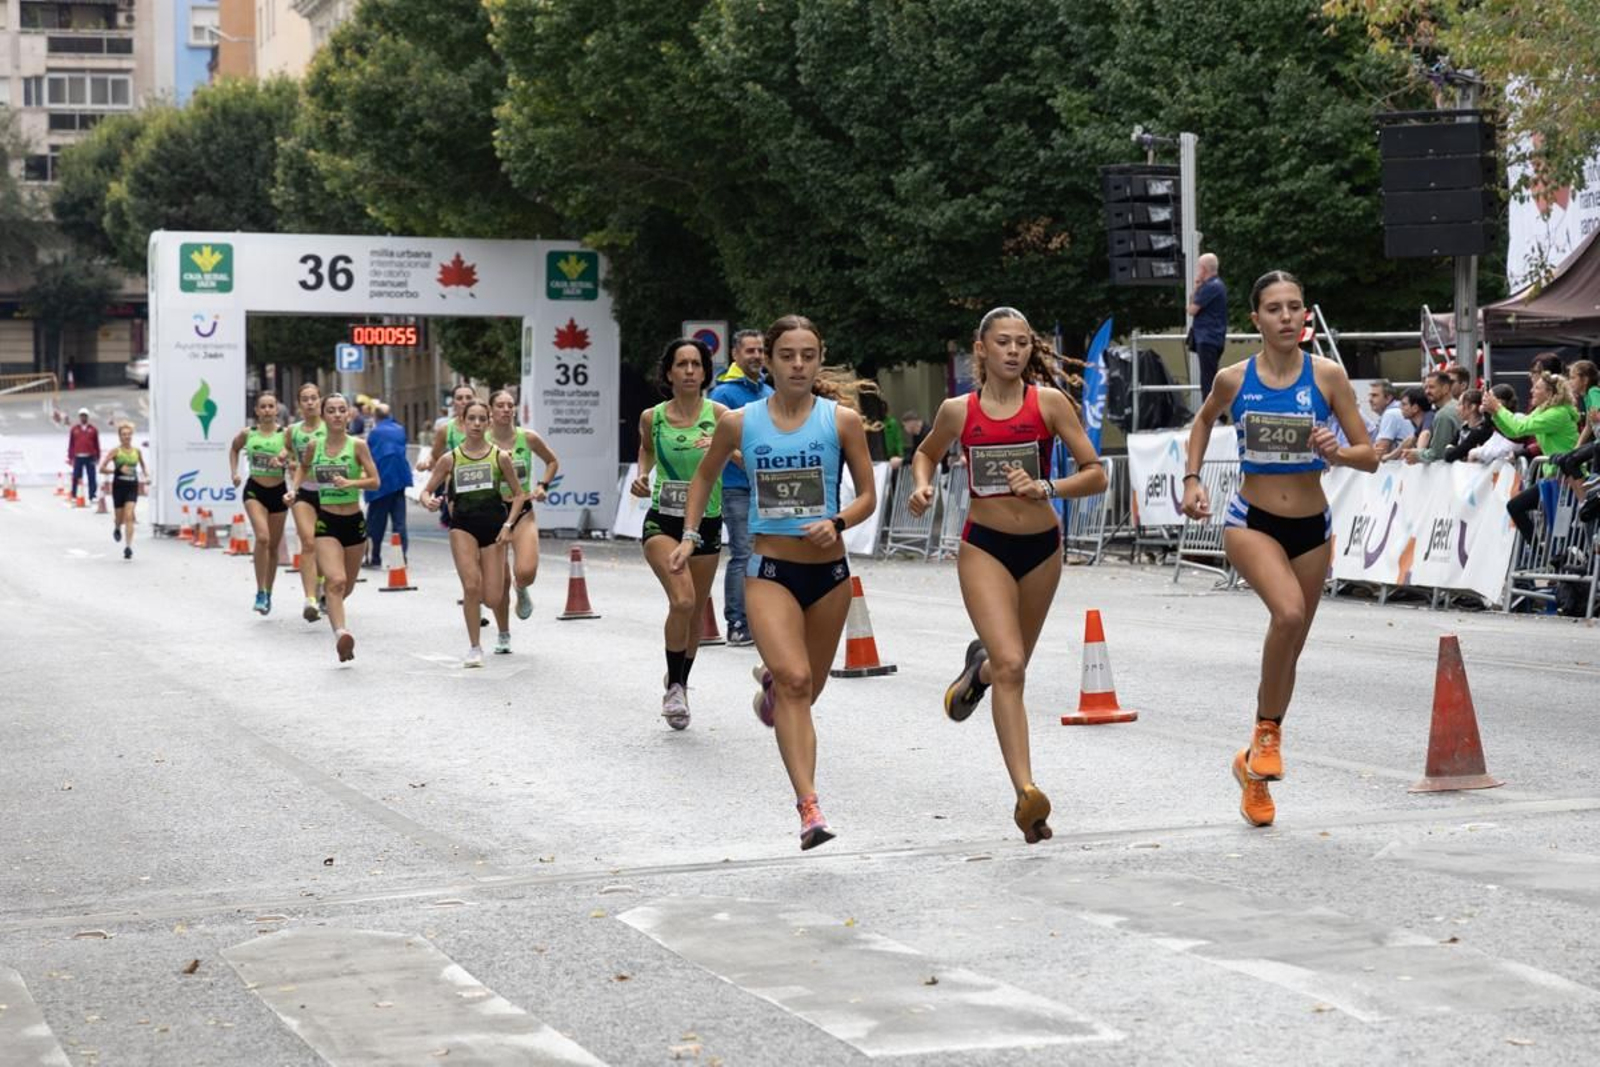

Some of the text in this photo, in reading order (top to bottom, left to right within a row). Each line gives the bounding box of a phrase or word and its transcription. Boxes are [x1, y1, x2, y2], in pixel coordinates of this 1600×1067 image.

[369, 249, 432, 259] milla urbana
[370, 259, 431, 269] internacional
[298, 254, 354, 291] 36
[370, 279, 408, 288] manuel
[369, 289, 420, 299] pancorbo
[341, 347, 359, 369] P
[555, 363, 589, 386] 36
[543, 389, 600, 397] milla urbana
[554, 416, 589, 424] manuel
[548, 426, 595, 436] pancorbo
[1259, 427, 1298, 444] 240
[175, 469, 237, 501] Forus
[776, 482, 802, 498] 97
